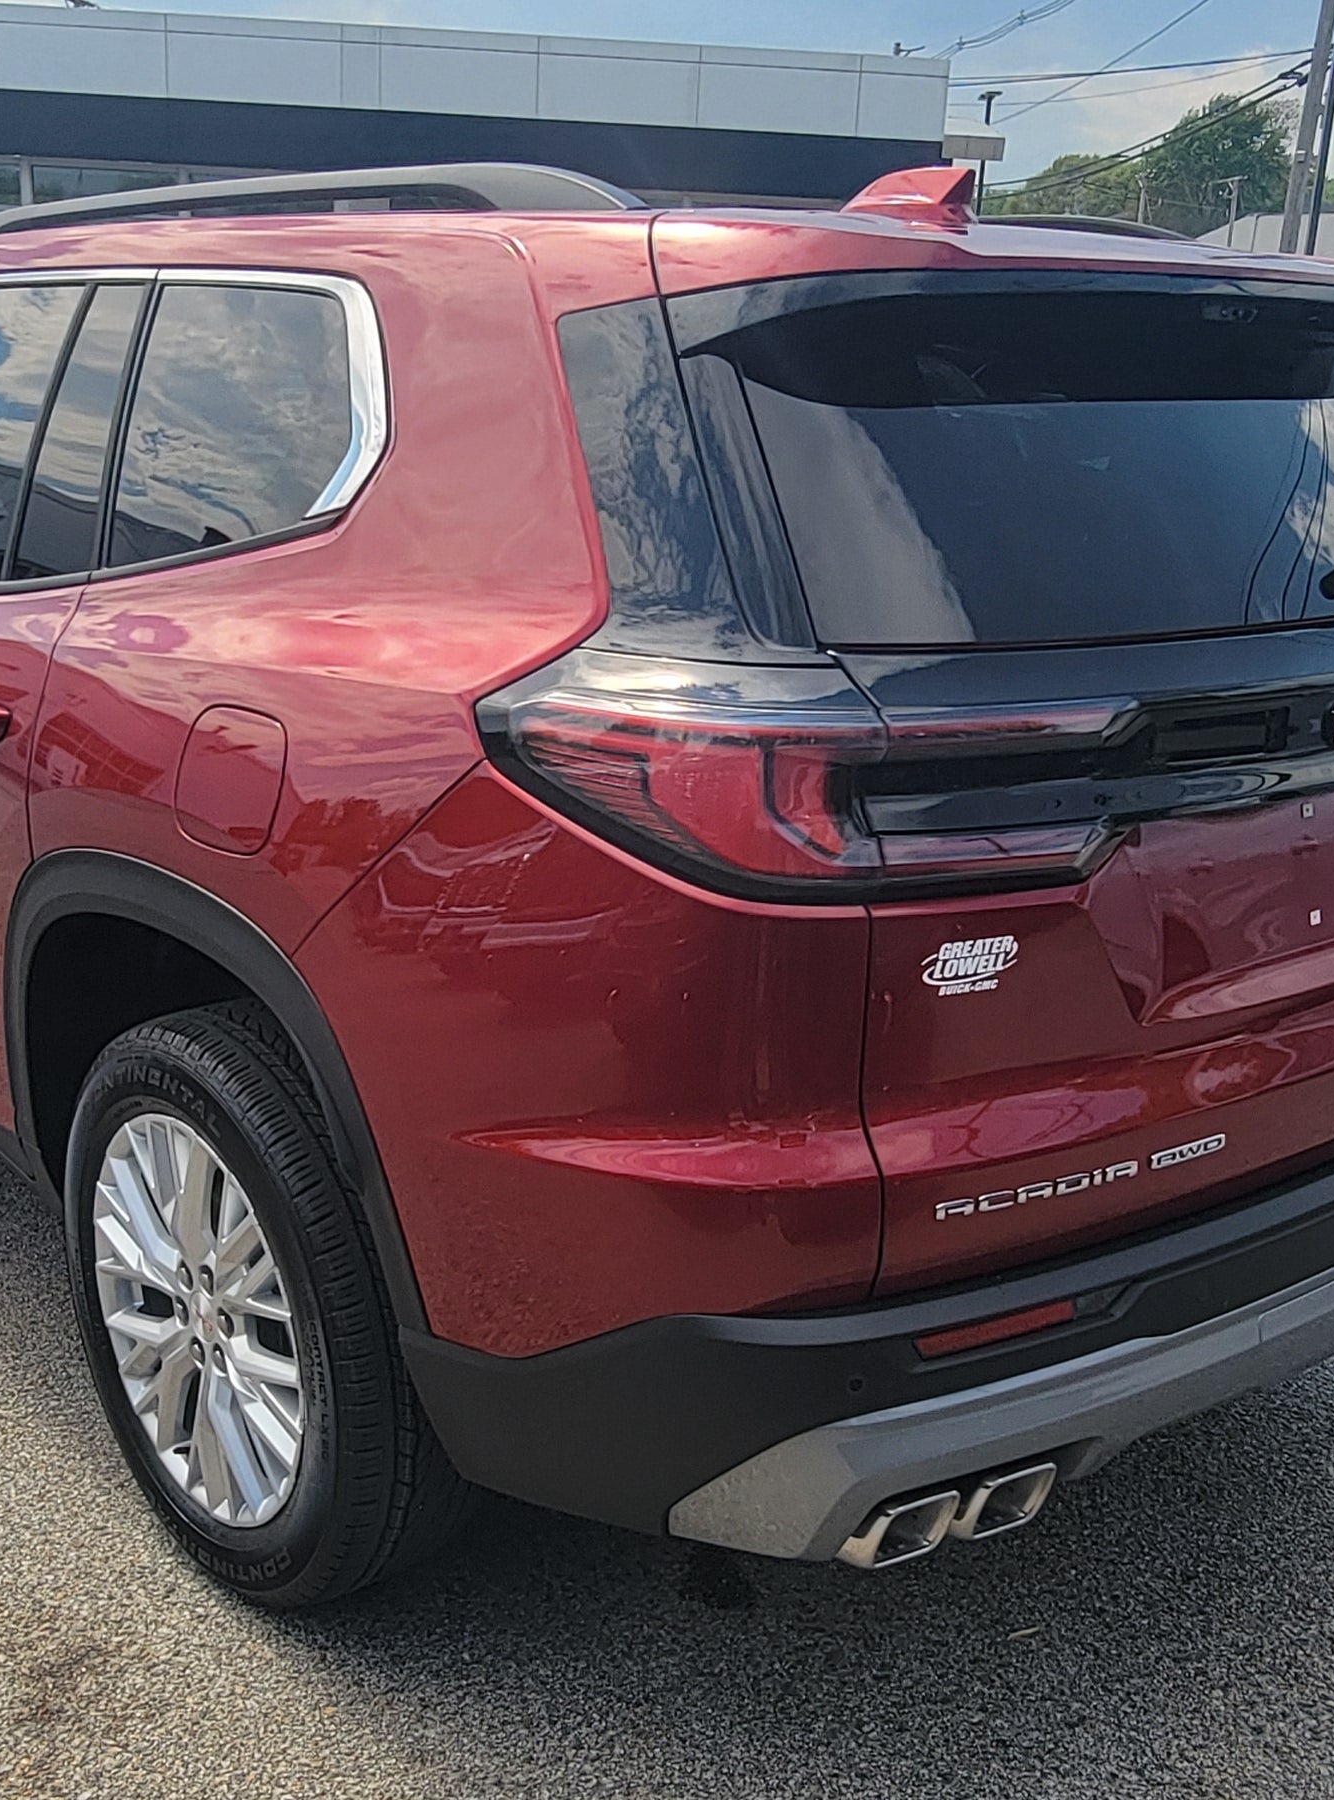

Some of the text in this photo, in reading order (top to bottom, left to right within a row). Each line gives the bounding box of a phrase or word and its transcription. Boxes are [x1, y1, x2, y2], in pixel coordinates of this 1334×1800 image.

[938, 935, 1015, 960] GREATER
[932, 953, 1007, 979] LOWELL
[935, 1137, 1223, 1221] ACADIA AWD
